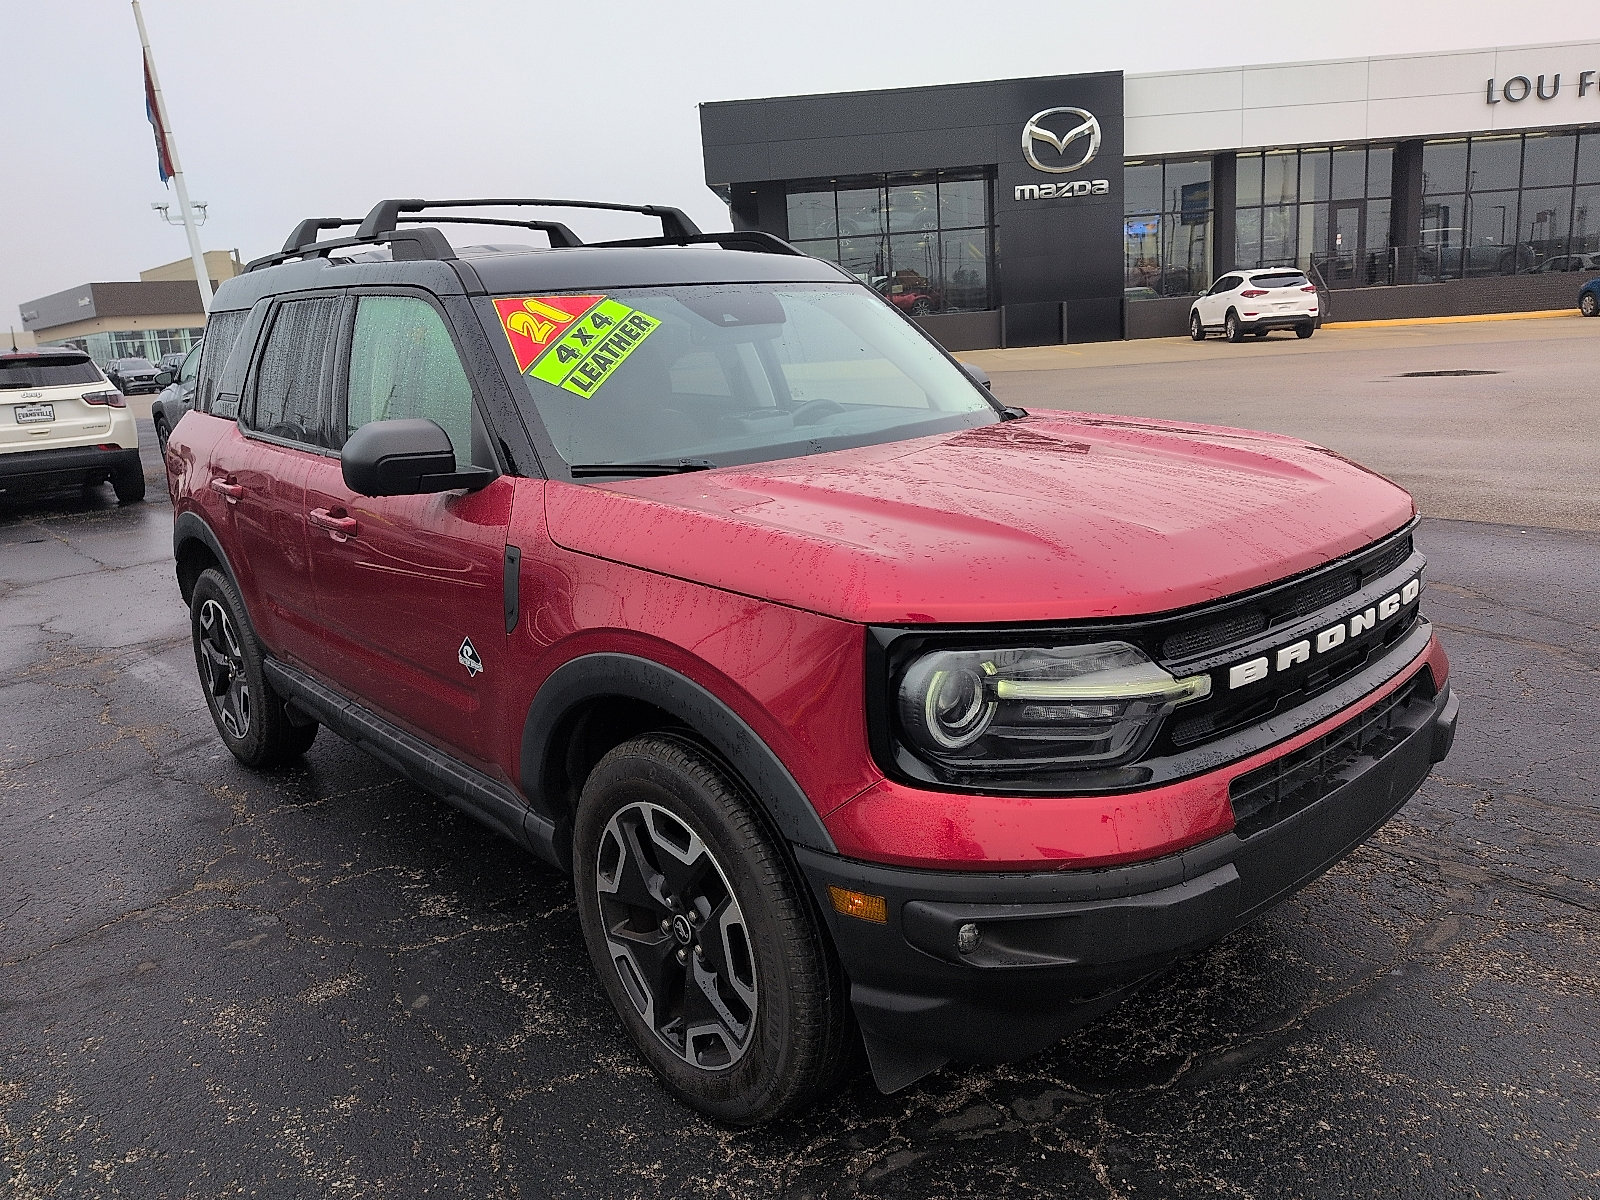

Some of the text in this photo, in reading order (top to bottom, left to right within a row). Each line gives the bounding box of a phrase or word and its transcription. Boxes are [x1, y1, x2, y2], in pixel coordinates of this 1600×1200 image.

[1487, 71, 1600, 104] LOU F
[1014, 179, 1109, 201] mazda
[507, 299, 575, 344] 21
[556, 343, 581, 364] 4
[591, 312, 615, 330] 4
[570, 315, 653, 392] LEATHER
[18, 410, 53, 420] EVANSVILLE
[1229, 578, 1420, 690] BRONCO
